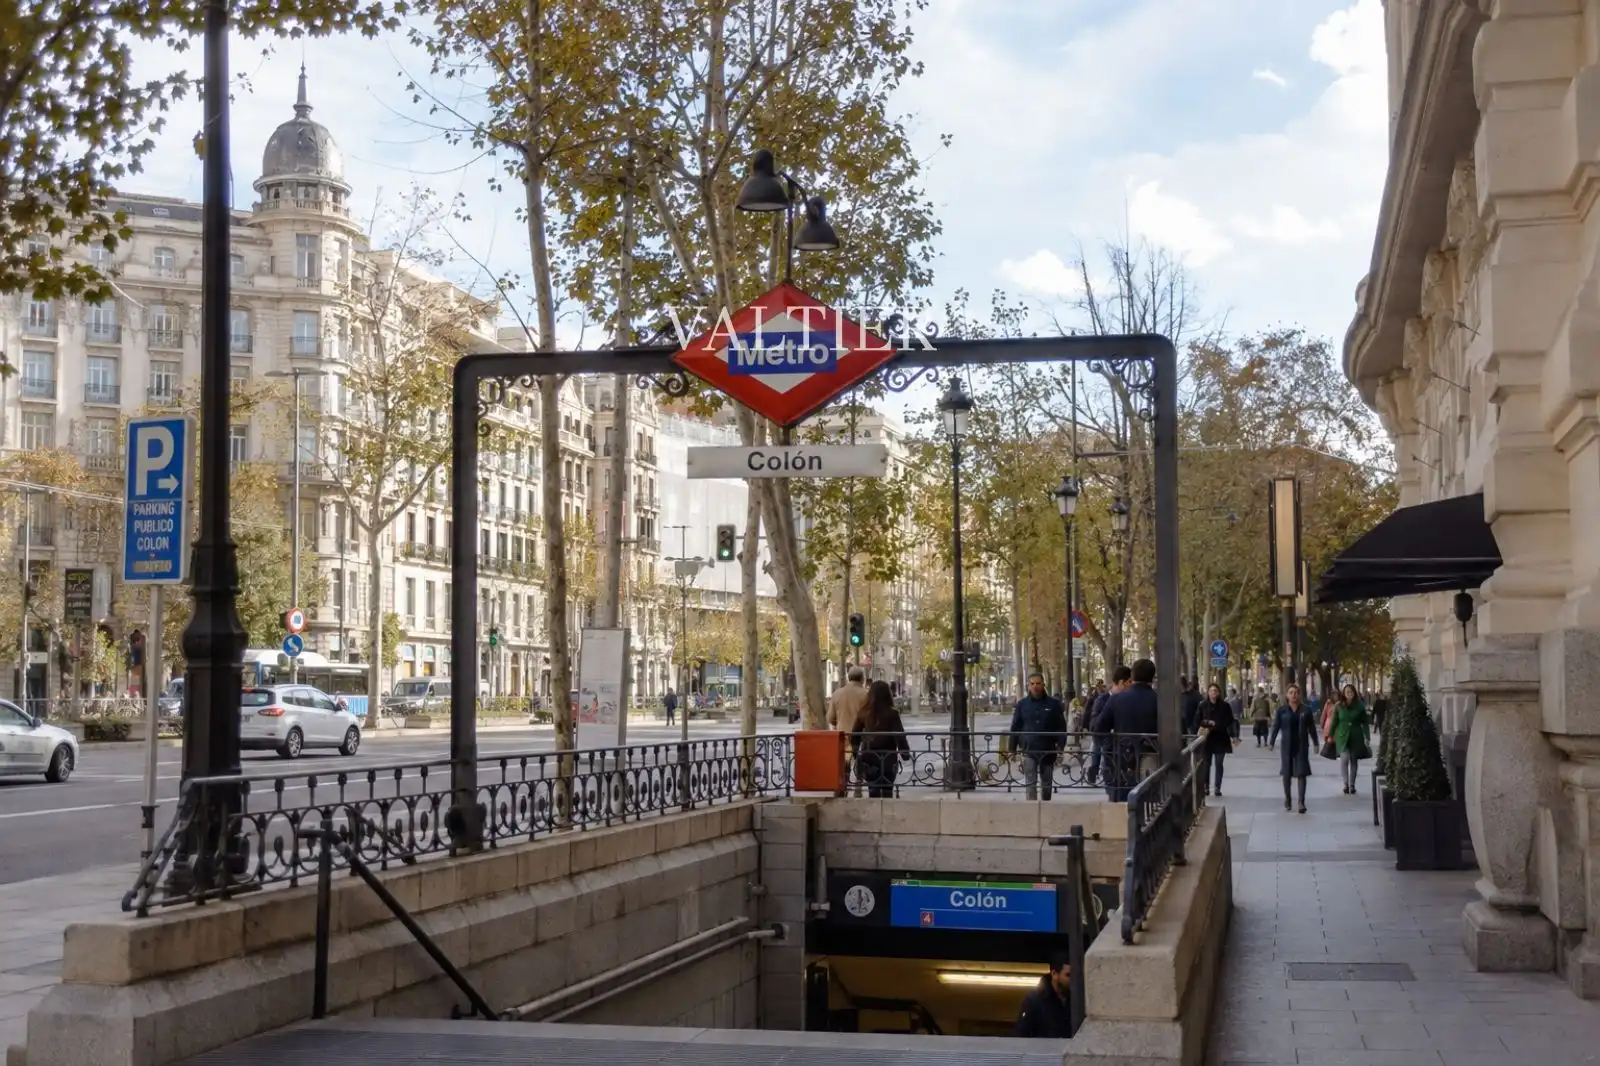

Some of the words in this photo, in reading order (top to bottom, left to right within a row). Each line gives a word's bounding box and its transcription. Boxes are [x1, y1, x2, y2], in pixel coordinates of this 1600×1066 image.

[737, 339, 829, 366] Metro
[135, 426, 174, 495] P
[748, 451, 822, 471] Colón
[134, 501, 175, 516] PARKING
[134, 518, 174, 533] PUBLICO
[136, 536, 170, 551] COLON
[950, 890, 1007, 909] Colón
